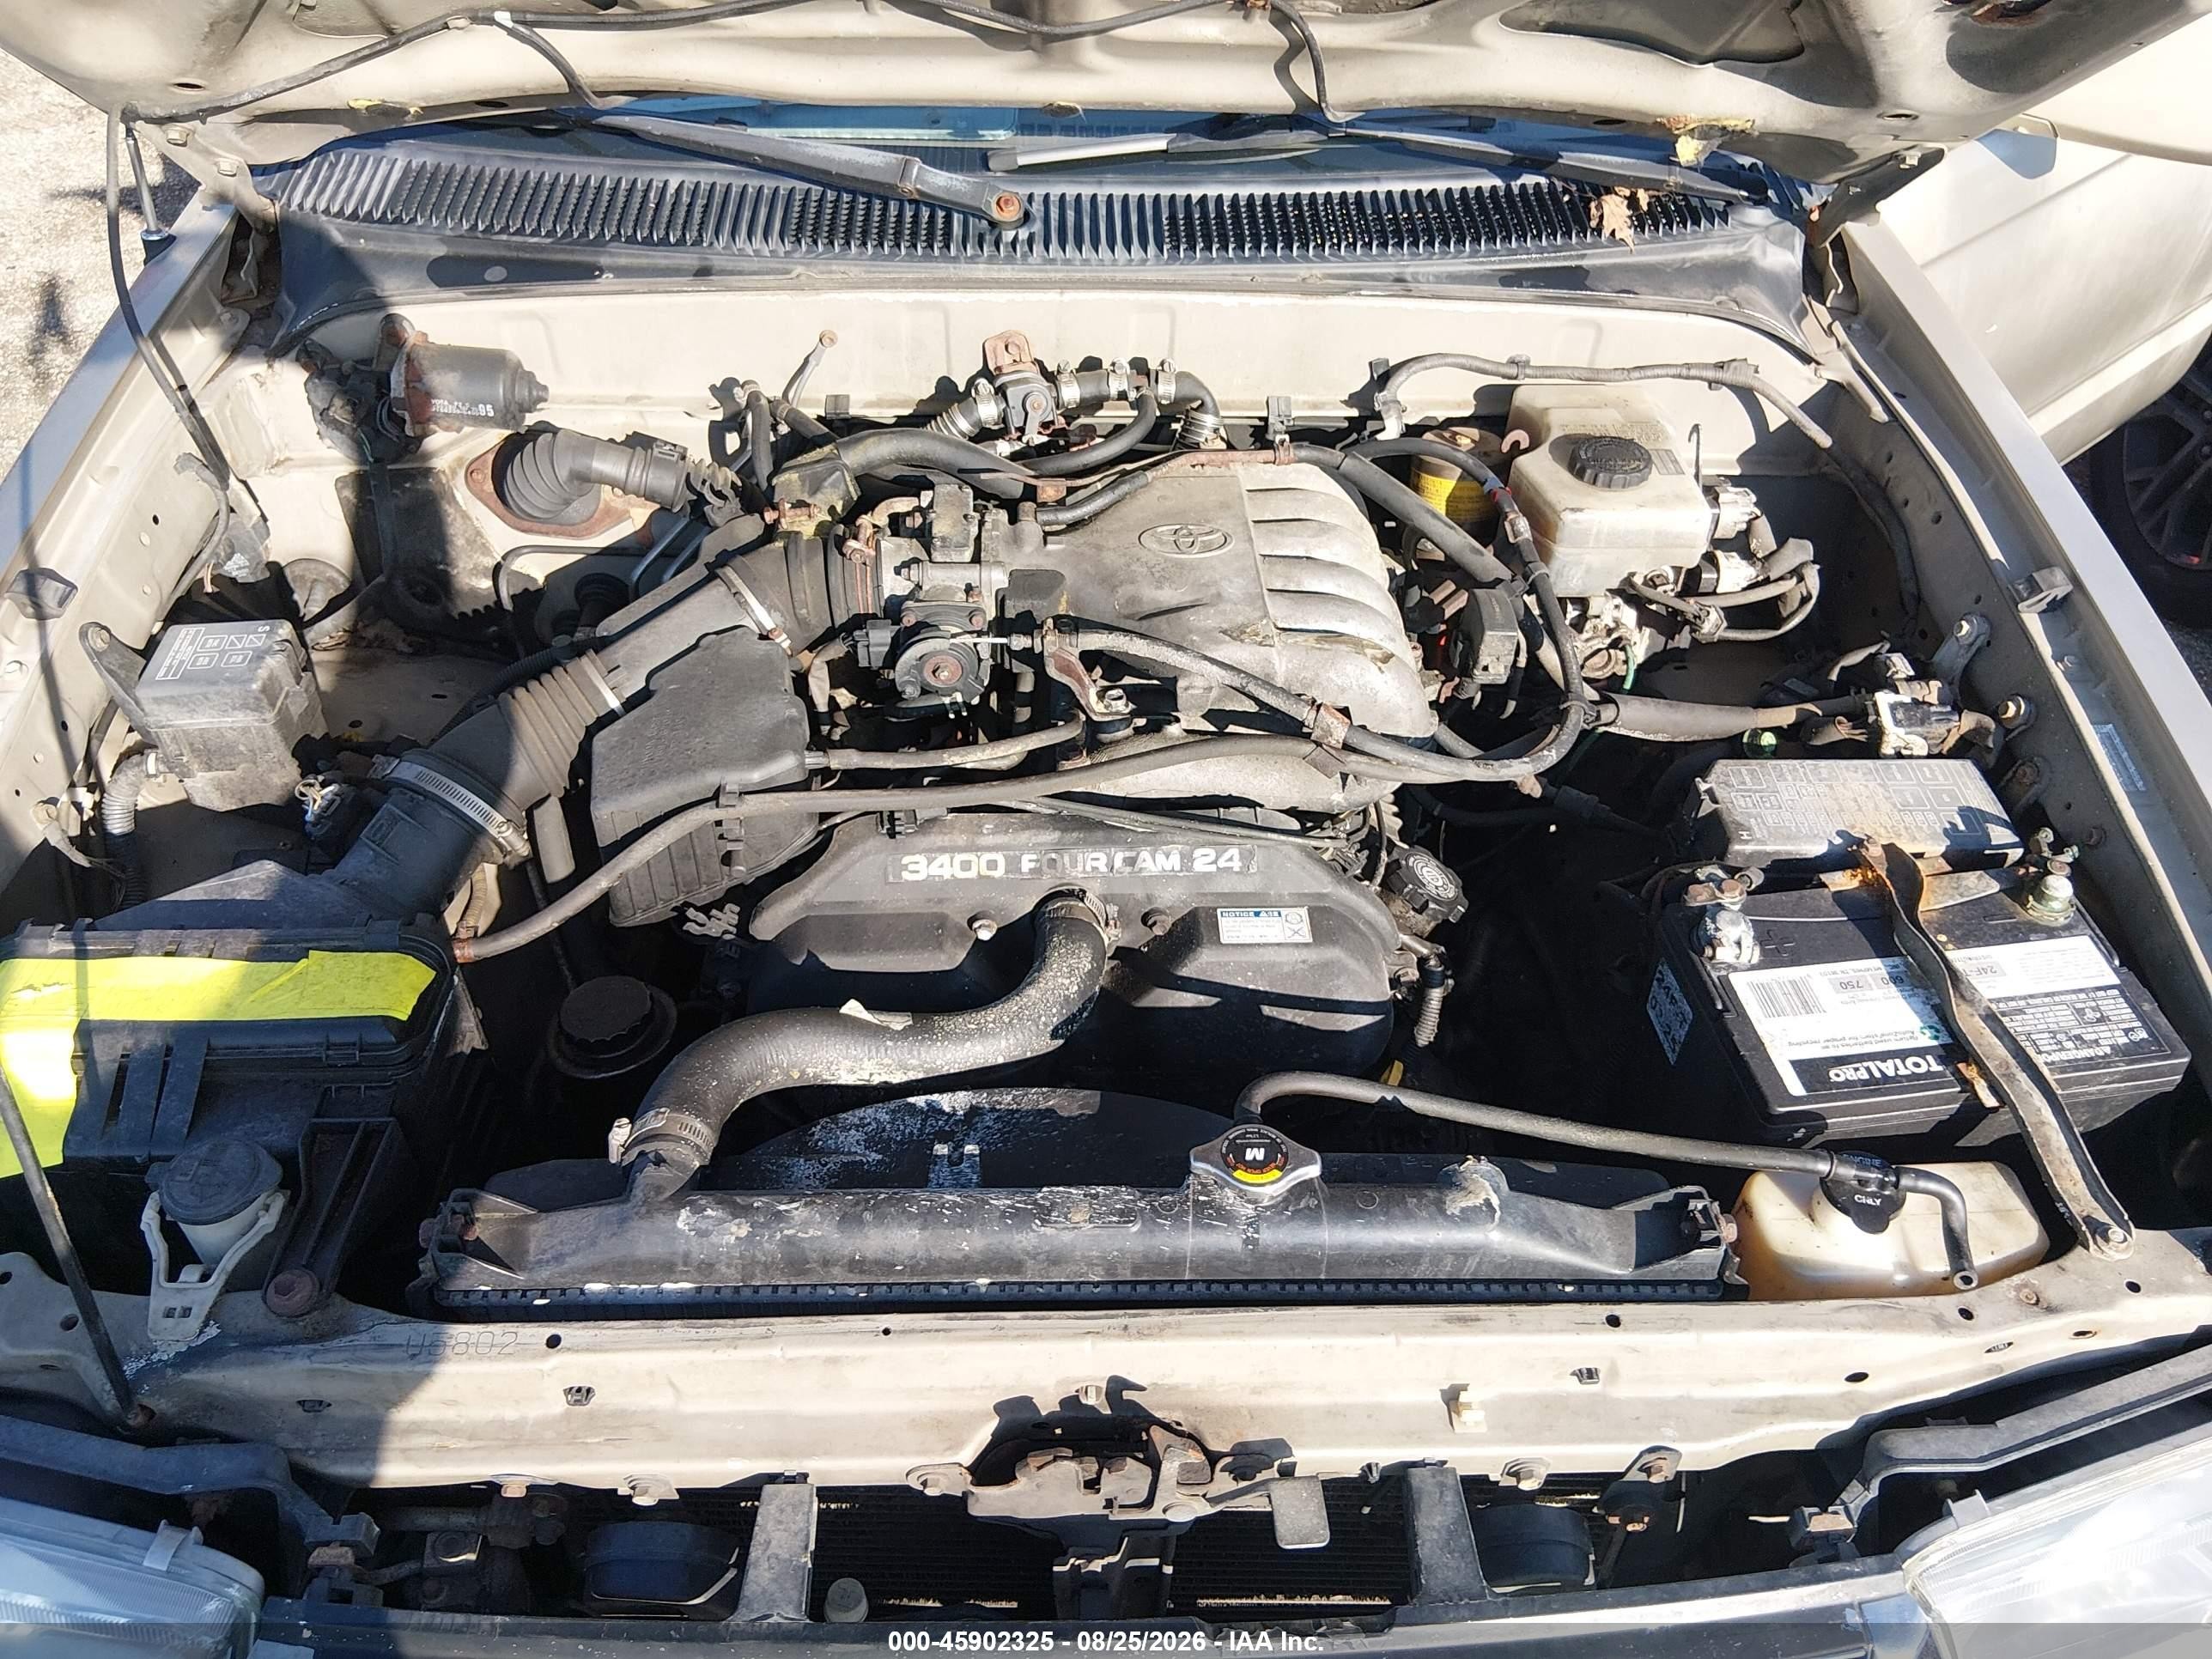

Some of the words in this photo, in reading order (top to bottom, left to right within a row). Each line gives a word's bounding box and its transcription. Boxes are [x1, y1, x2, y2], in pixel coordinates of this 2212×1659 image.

[901, 854, 1005, 881] 3400
[1020, 850, 1108, 875] FOUR
[1192, 848, 1242, 872] 24
[1839, 980, 1863, 990] 750
[1881, 975, 1905, 986] 600
[1828, 1054, 1943, 1083] TOTALPRO
[1244, 1147, 1265, 1161] M
